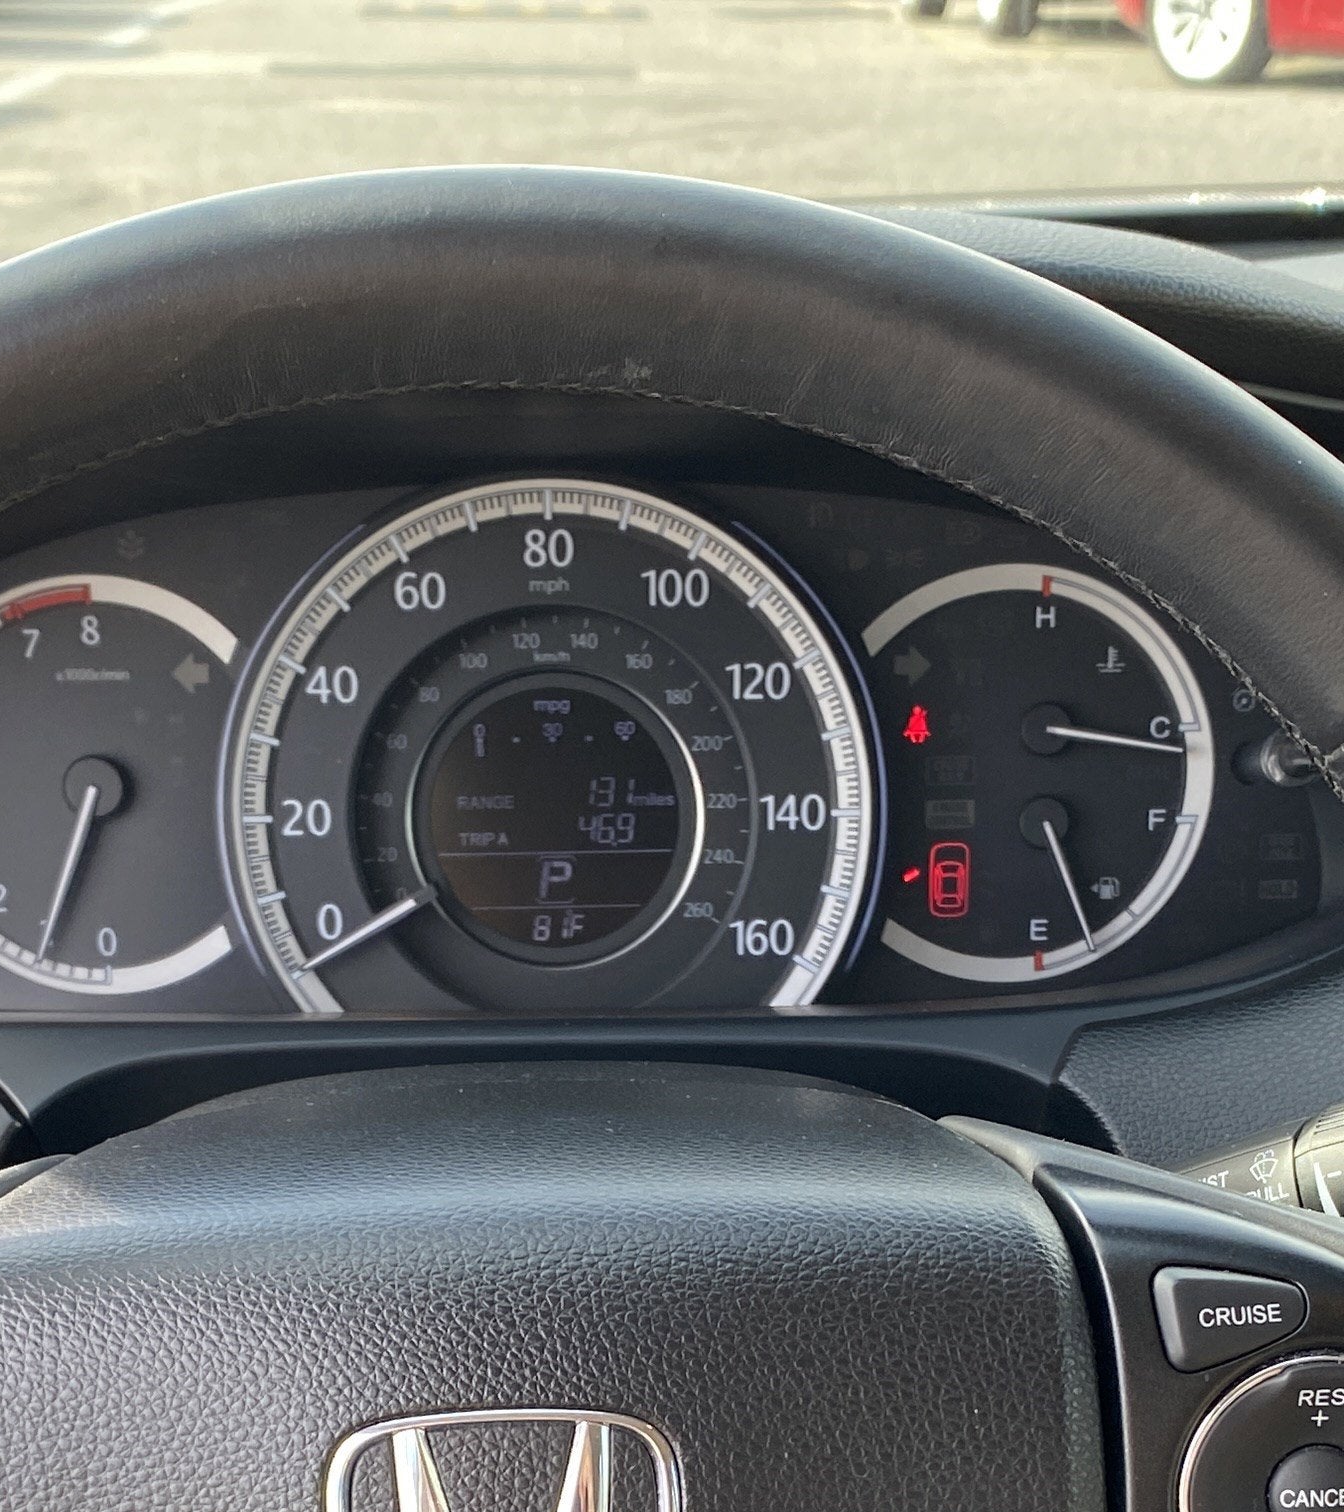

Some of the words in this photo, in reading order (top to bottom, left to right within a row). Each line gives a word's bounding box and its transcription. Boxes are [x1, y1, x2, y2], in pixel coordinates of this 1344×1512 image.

[523, 529, 574, 568] 80
[394, 571, 446, 609] 60
[529, 574, 570, 595] mph
[641, 569, 709, 608] 100
[1035, 606, 1056, 629] H
[81, 616, 100, 645] 8
[512, 633, 541, 649] 120
[570, 633, 598, 649] 140
[23, 630, 40, 658] 7
[460, 653, 488, 668] 100
[625, 654, 653, 669] 160
[306, 666, 358, 704] 40
[725, 662, 791, 701] 120
[533, 700, 571, 714] mpg
[665, 689, 692, 705] 180
[1149, 716, 1171, 740] C
[691, 736, 724, 752] 200
[457, 796, 514, 810] RANGE
[707, 794, 737, 808] 220
[282, 800, 332, 837] 20
[760, 795, 826, 832] 140
[1147, 809, 1166, 832] F
[704, 850, 734, 864] 240
[540, 861, 572, 898] P
[317, 903, 343, 940] 0
[683, 903, 713, 918] 260
[99, 927, 117, 956] 0
[730, 919, 794, 957] 160
[1029, 919, 1049, 942] E
[1198, 1303, 1283, 1329] CRUISE
